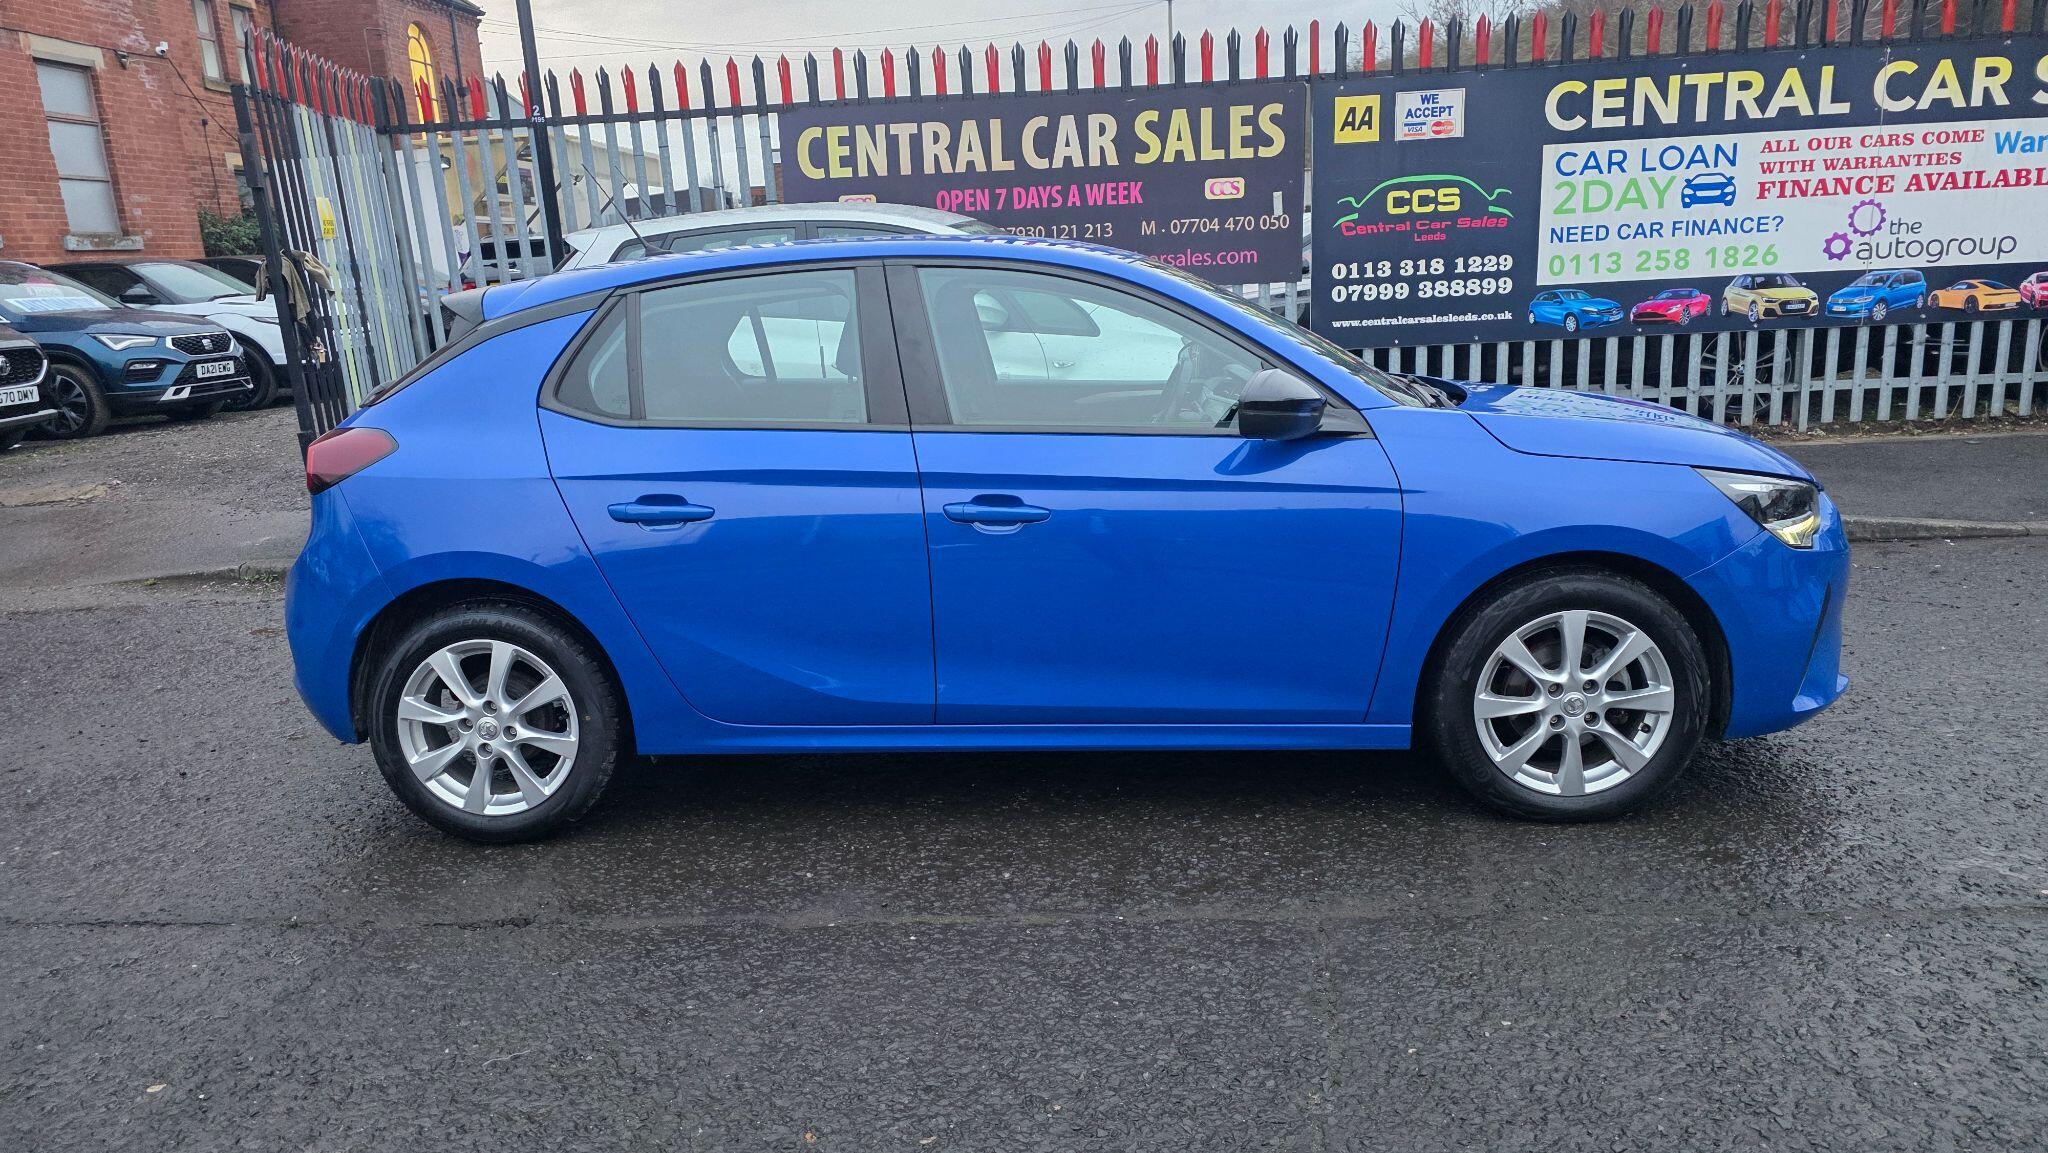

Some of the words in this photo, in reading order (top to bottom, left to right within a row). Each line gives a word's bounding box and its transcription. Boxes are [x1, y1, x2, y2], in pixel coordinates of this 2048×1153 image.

[1420, 94, 1439, 105] WE
[1545, 65, 1850, 131] CENTRAL
[1874, 56, 2012, 112] CAR
[532, 105, 540, 116] 2
[1340, 106, 1373, 132] AA
[1405, 106, 1454, 119] ACCEPT
[797, 118, 1015, 180] CENTRAL
[1020, 113, 1119, 170] CAR
[1134, 103, 1286, 165] SALES
[1760, 139, 1800, 154] ALL
[1807, 136, 1852, 151] OUR
[1859, 132, 1915, 148] CARS
[1921, 129, 1985, 145] COME
[1994, 131, 2048, 153] War
[1555, 149, 1628, 177] CAR
[1641, 143, 1738, 172] LOAN
[1759, 159, 1815, 175] WITH
[1822, 151, 1962, 172] WARRANTIES
[936, 187, 990, 213] OPEN
[995, 188, 1008, 212] 7
[1013, 184, 1063, 210] DAYS
[1067, 184, 1081, 207] A
[1085, 181, 1144, 206] WEEK
[1209, 181, 1241, 197] CCS
[1552, 175, 1678, 215] 2DAY
[1756, 174, 1895, 200] FINANCE
[1387, 187, 1461, 215] CCS
[1000, 225, 1045, 237] 7930
[1051, 224, 1077, 239] 121
[1084, 222, 1113, 238] 213
[1170, 217, 1220, 234] 07704
[1225, 216, 1254, 231] 470
[1259, 214, 1290, 230] 050
[1341, 220, 1411, 236] Central
[1415, 219, 1451, 230] Car
[1456, 216, 1508, 228] Sales
[1550, 225, 1610, 244] NEED
[1617, 221, 1664, 240] CAR
[1671, 215, 1784, 237] FINANCE?
[1889, 217, 1922, 235] the
[1414, 232, 1447, 242] Leeds
[1856, 235, 2018, 263] autogroup
[1331, 260, 1392, 280] 0113
[1399, 258, 1445, 276] 318
[1454, 254, 1514, 273] 1229
[1548, 251, 1622, 277] 0113
[1635, 248, 1690, 273] 258
[1705, 243, 1779, 269] 1826
[1331, 282, 1410, 303] 07999
[1417, 277, 1513, 298] 388899
[1332, 310, 1513, 328] www.centralcarsalesleeds.co.uk
[17, 388, 34, 402] DMY
